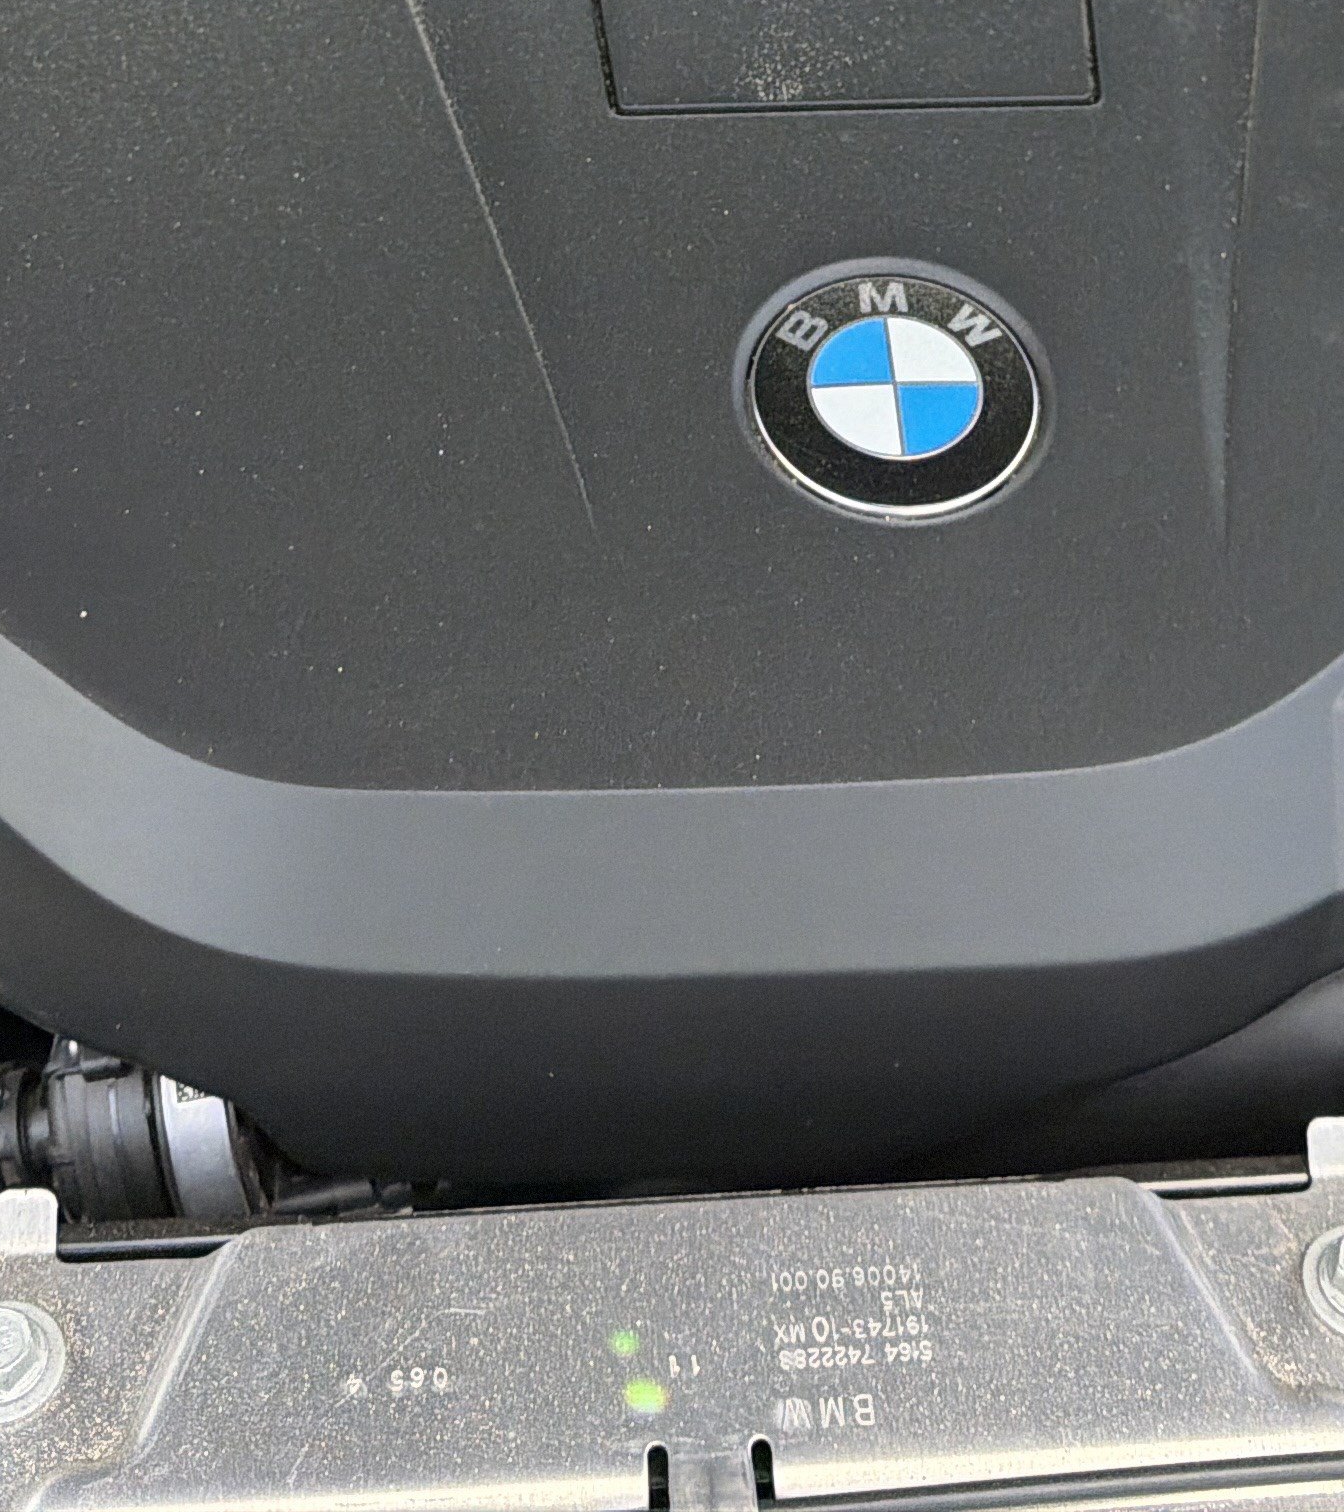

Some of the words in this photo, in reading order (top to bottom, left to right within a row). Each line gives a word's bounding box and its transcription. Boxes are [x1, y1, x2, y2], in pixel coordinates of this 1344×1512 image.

[775, 281, 1003, 353] BMW
[774, 1321, 806, 1344] MX
[884, 1340, 933, 1363] 5164
[782, 1393, 876, 1431] BMW
